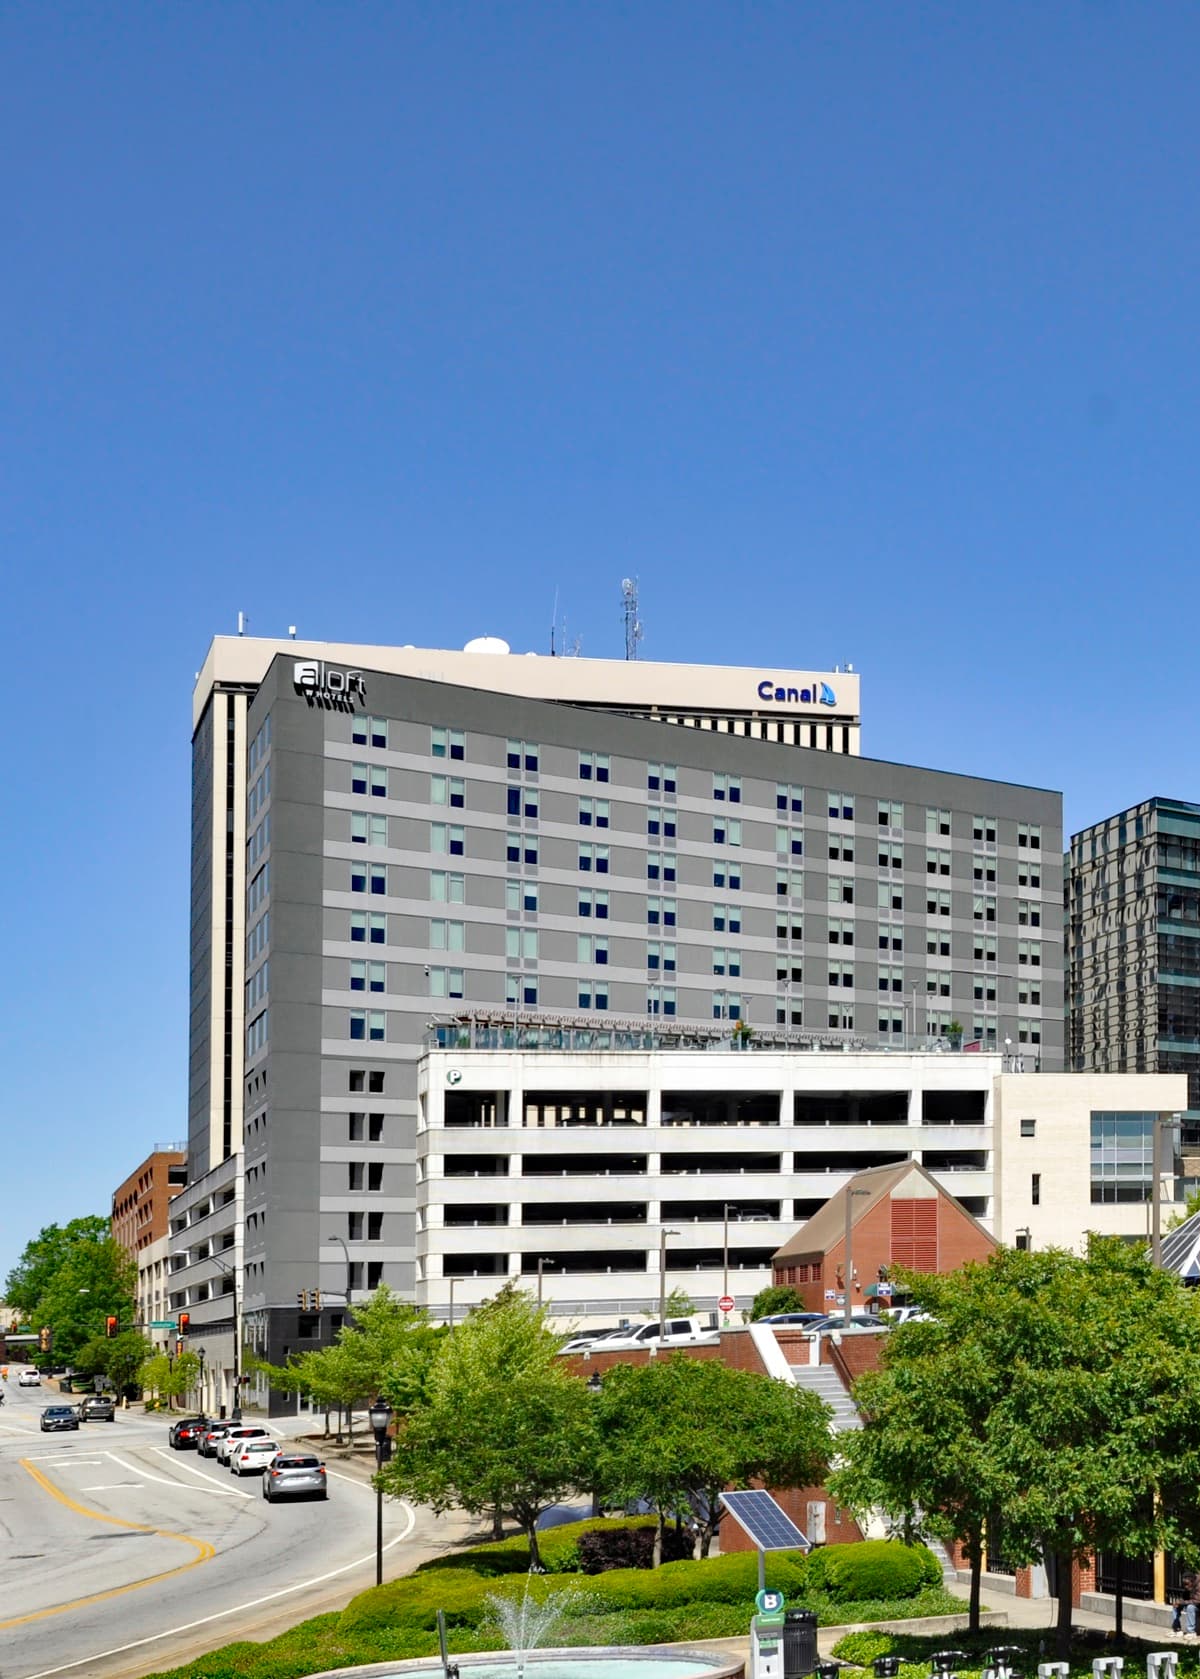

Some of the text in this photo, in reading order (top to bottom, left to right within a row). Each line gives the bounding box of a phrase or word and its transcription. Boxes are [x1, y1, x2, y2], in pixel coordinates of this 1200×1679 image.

[294, 661, 365, 695] aloft
[316, 691, 354, 703] HOTELS
[758, 681, 817, 704] Canal
[764, 1594, 778, 1609] B
